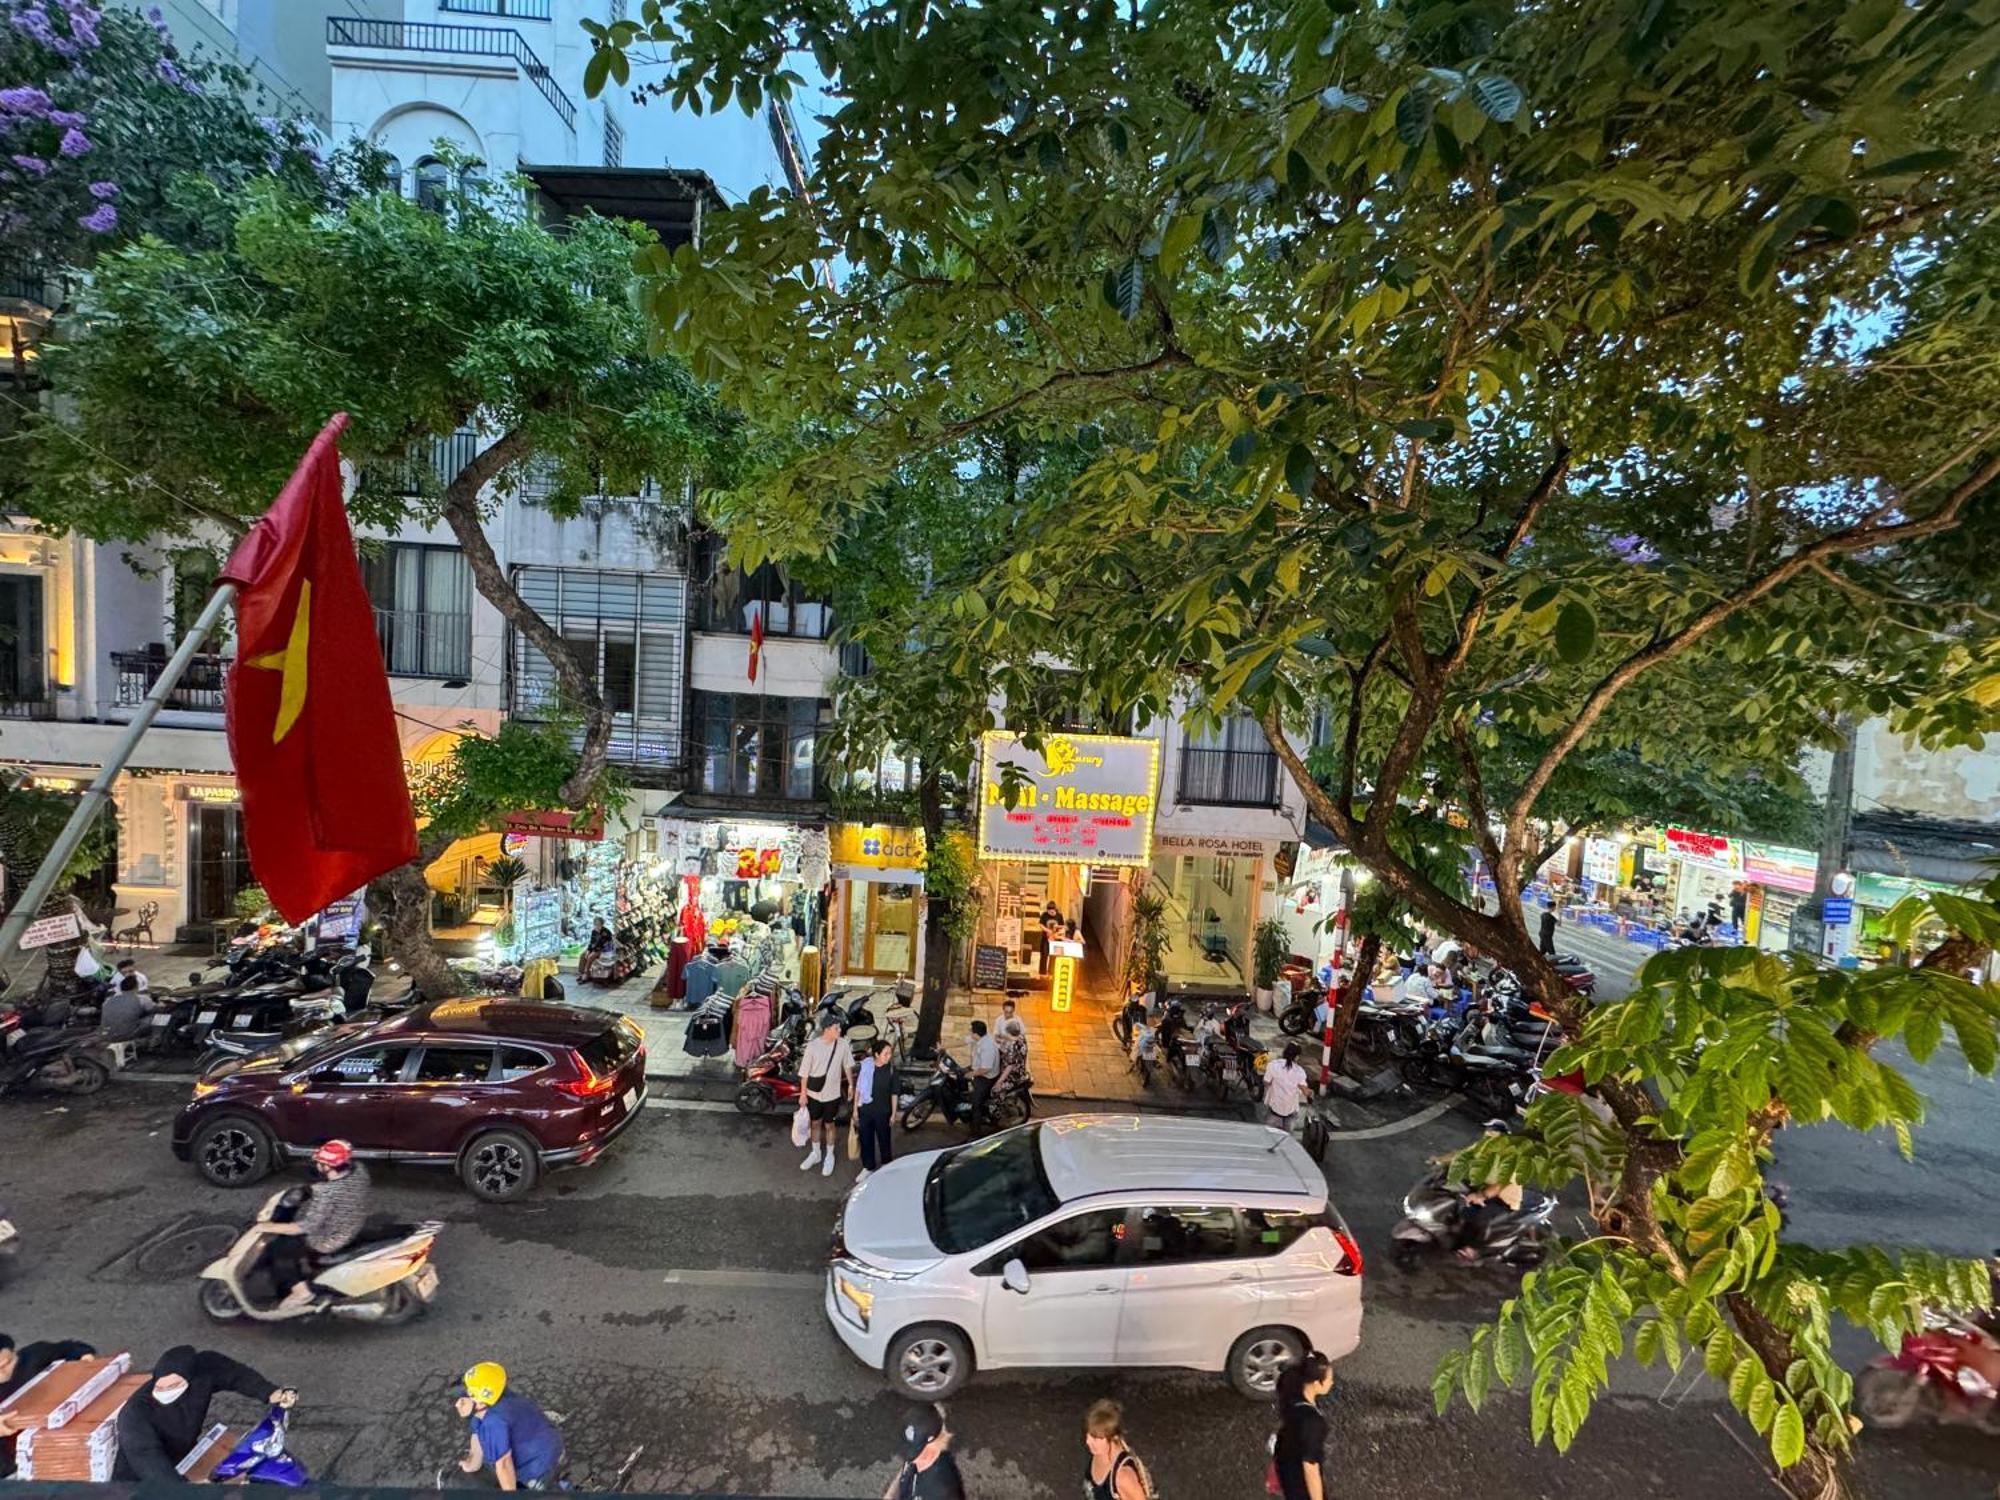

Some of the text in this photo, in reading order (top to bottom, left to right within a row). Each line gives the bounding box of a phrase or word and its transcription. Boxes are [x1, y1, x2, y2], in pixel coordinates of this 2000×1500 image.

[987, 782, 1150, 817] Nil Massage
[1162, 836, 1265, 852] BELLA ROSA HOTEL
